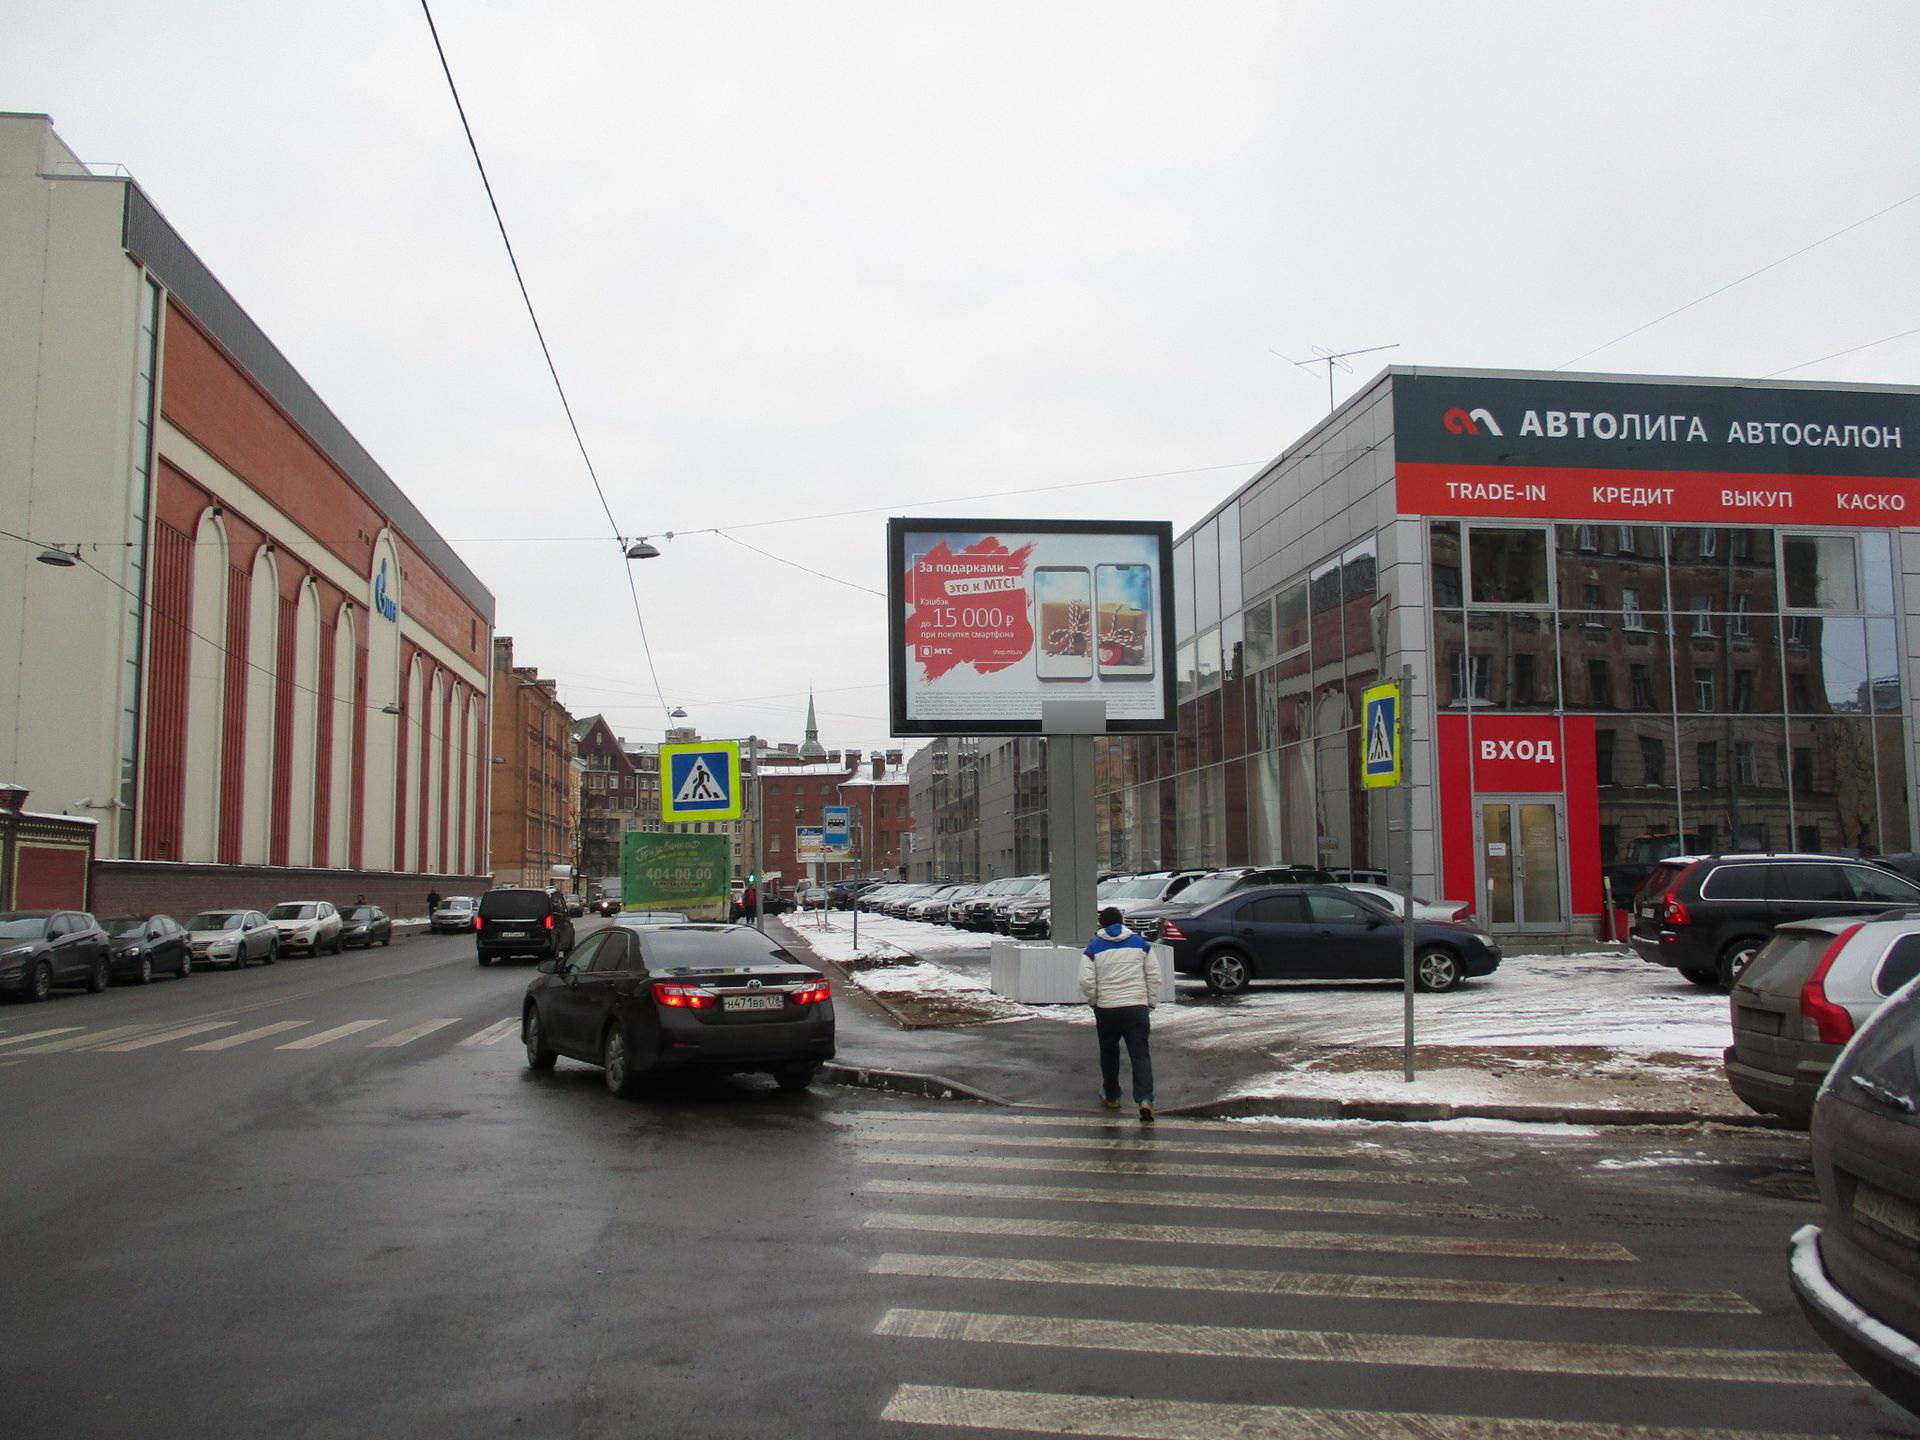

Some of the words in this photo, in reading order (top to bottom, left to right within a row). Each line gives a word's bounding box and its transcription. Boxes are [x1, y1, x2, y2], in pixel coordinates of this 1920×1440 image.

[1519, 408, 1708, 443] АВТОЛИГА
[1726, 420, 1904, 449] АВТОСАЛОН
[1446, 482, 1548, 502] TRADE-IN
[1591, 486, 1675, 508] КРЕДИТ
[1720, 490, 1793, 508] ВЫКУП
[1836, 493, 1906, 511] КАСКО
[919, 562, 933, 573] За
[936, 563, 1004, 575] подарками
[949, 584, 969, 593] это
[973, 583, 980, 591] к
[984, 577, 1016, 590] МТС!
[920, 597, 949, 605] Кэшбэк
[921, 632, 936, 640] при
[938, 632, 970, 640] покупке
[971, 630, 1014, 639] смартфона
[1480, 740, 1555, 763] ВХОД
[646, 868, 713, 881] 404-00-00
